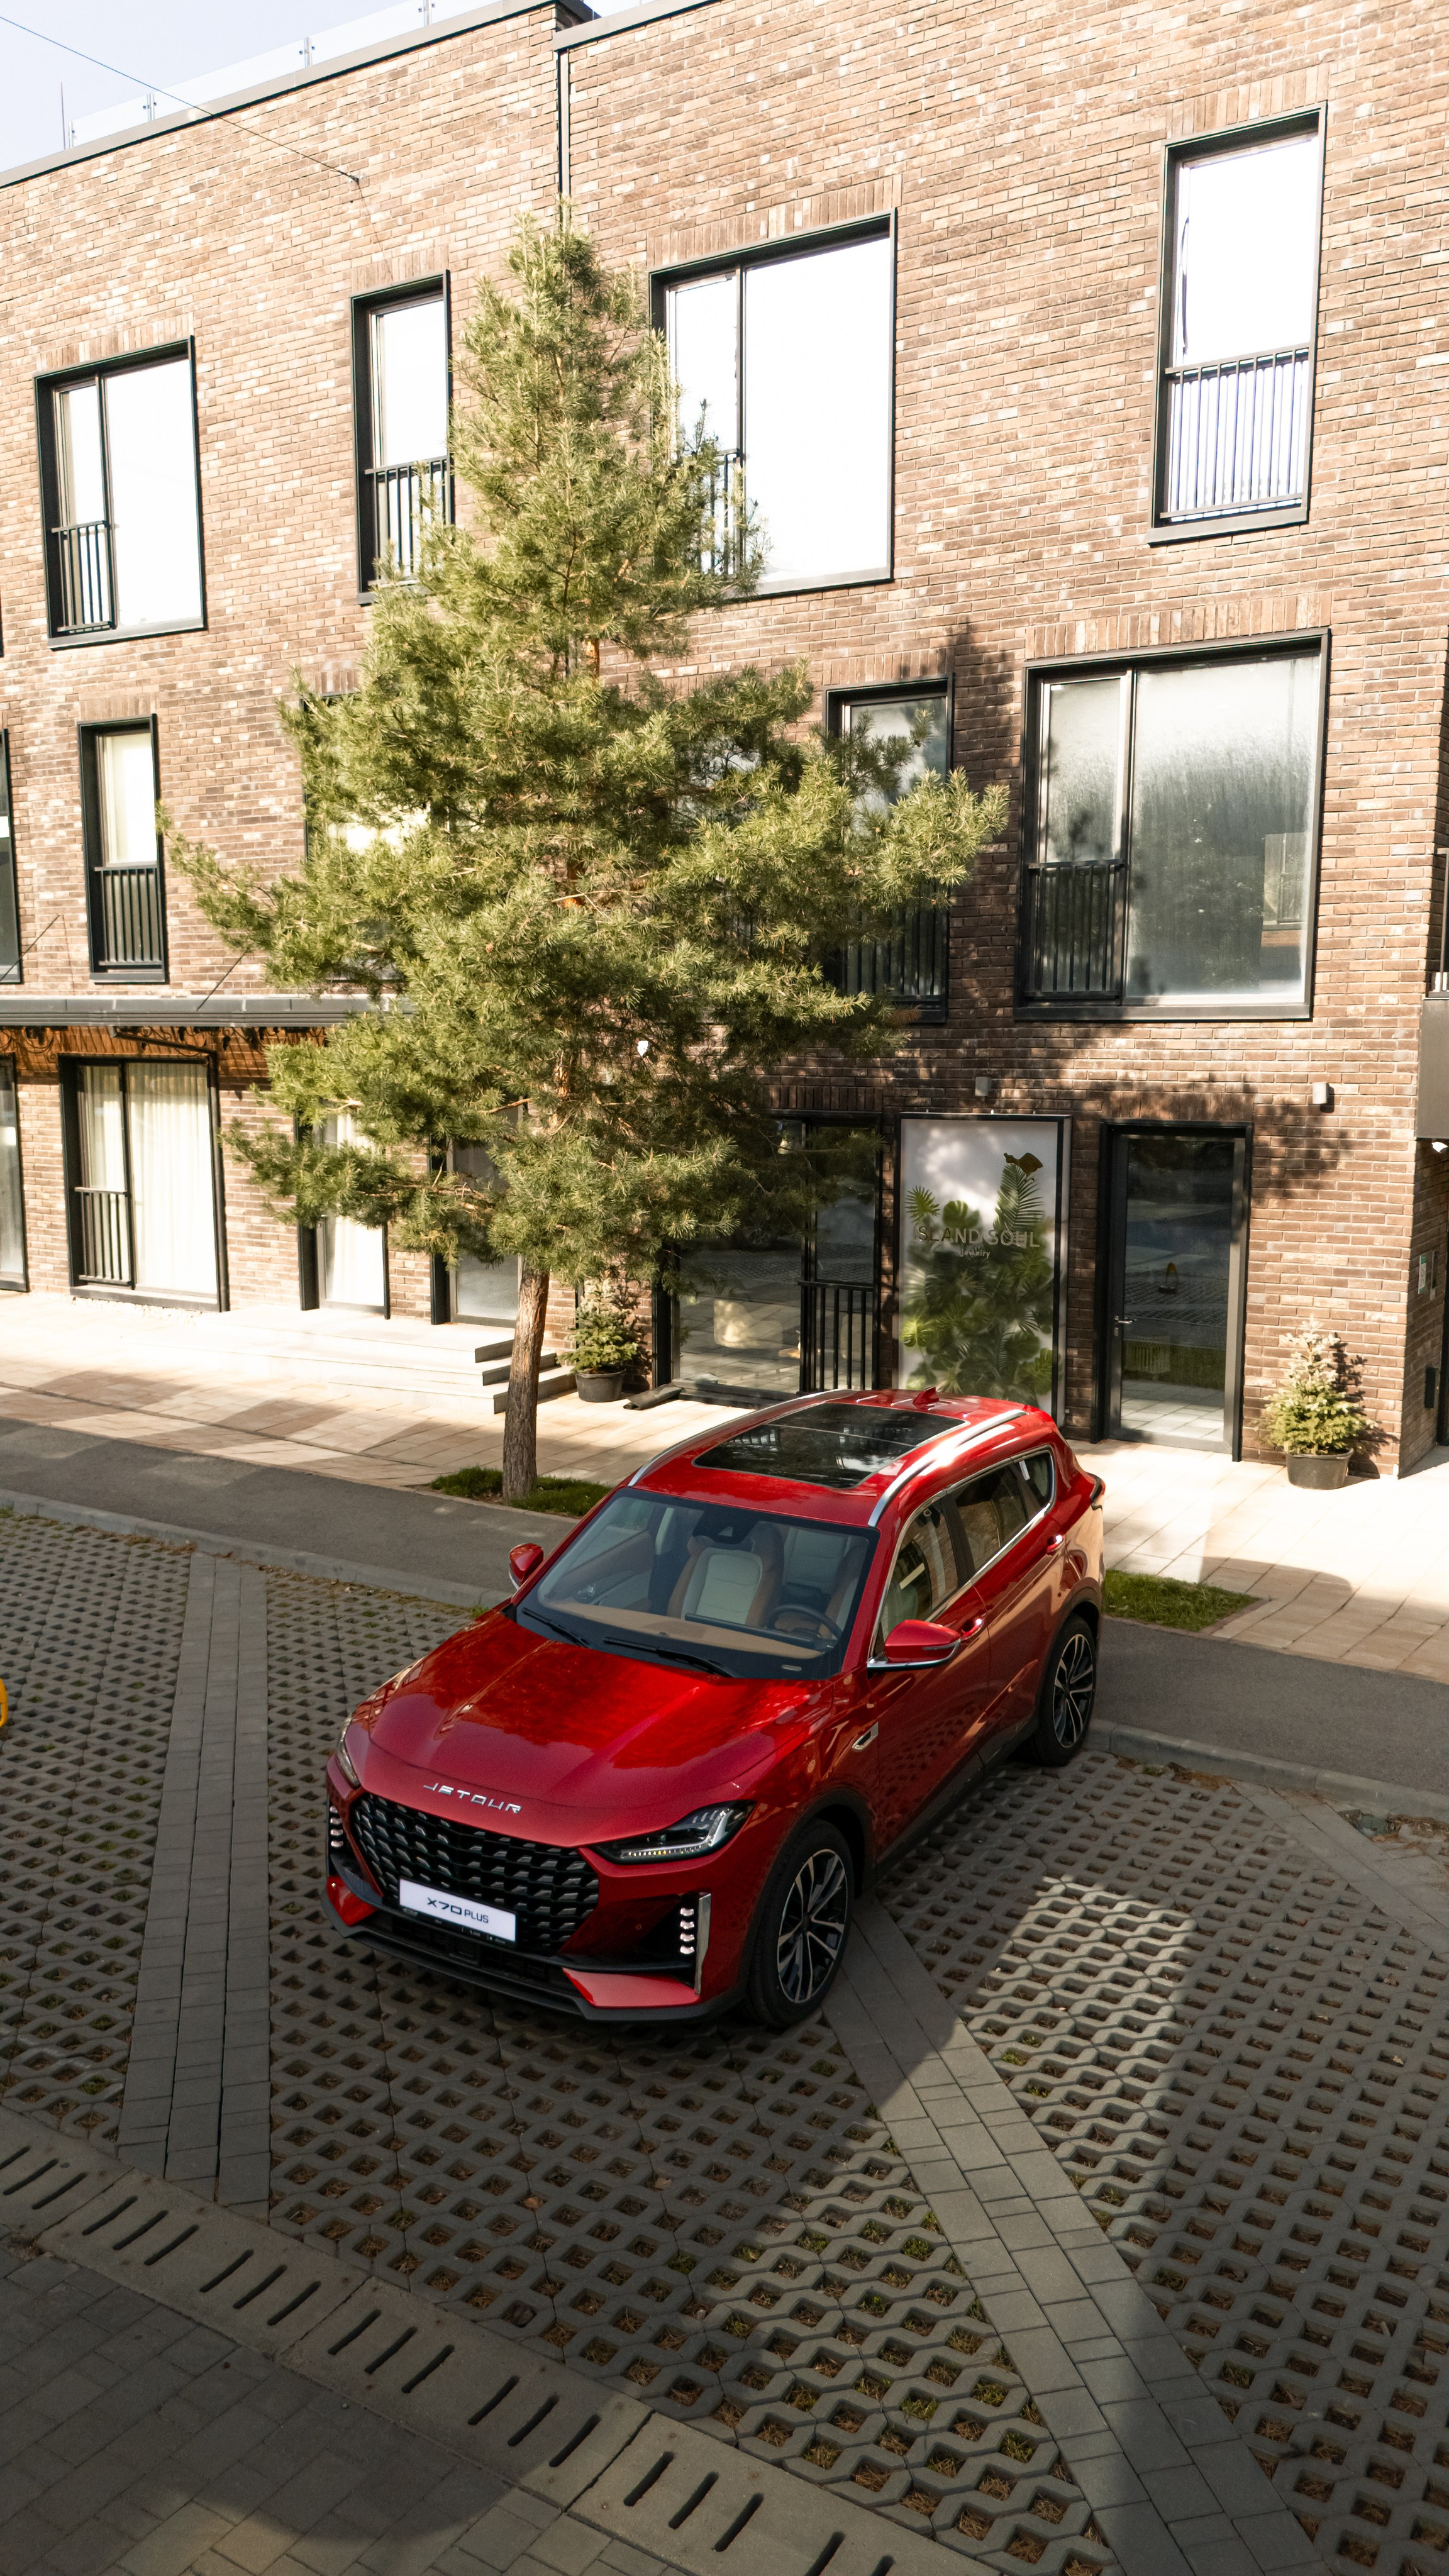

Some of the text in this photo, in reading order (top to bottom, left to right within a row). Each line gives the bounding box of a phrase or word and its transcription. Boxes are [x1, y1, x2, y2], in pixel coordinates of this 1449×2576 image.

[913, 1226, 1040, 1248] ISLAND SOUL
[423, 1782, 522, 1814] JETOUR
[427, 1897, 462, 1915] X70
[464, 1909, 489, 1924] PLUS
